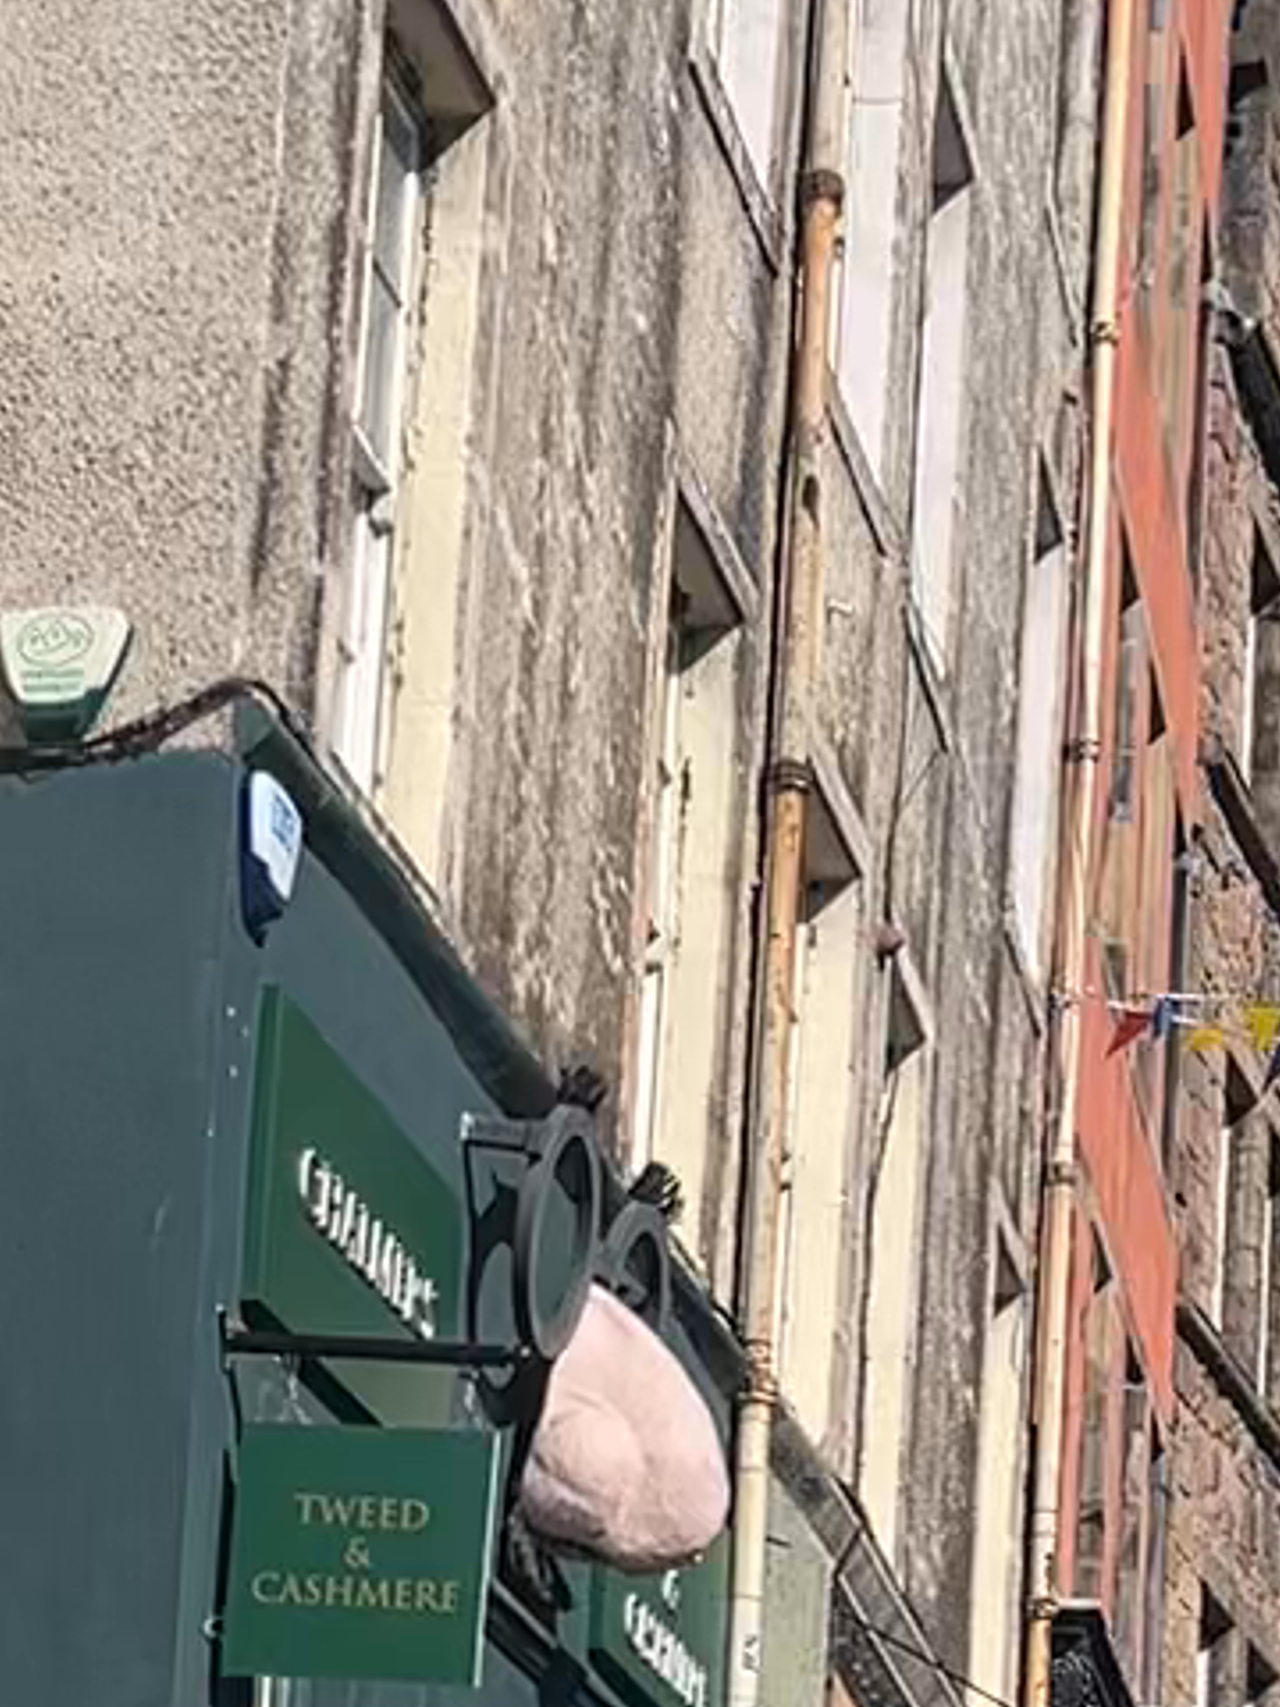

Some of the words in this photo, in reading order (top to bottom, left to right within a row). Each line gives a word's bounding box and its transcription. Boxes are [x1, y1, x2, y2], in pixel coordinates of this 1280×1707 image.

[294, 1491, 430, 1531] TWEED
[343, 1536, 372, 1569] &
[251, 1571, 460, 1614] CASHMERE
